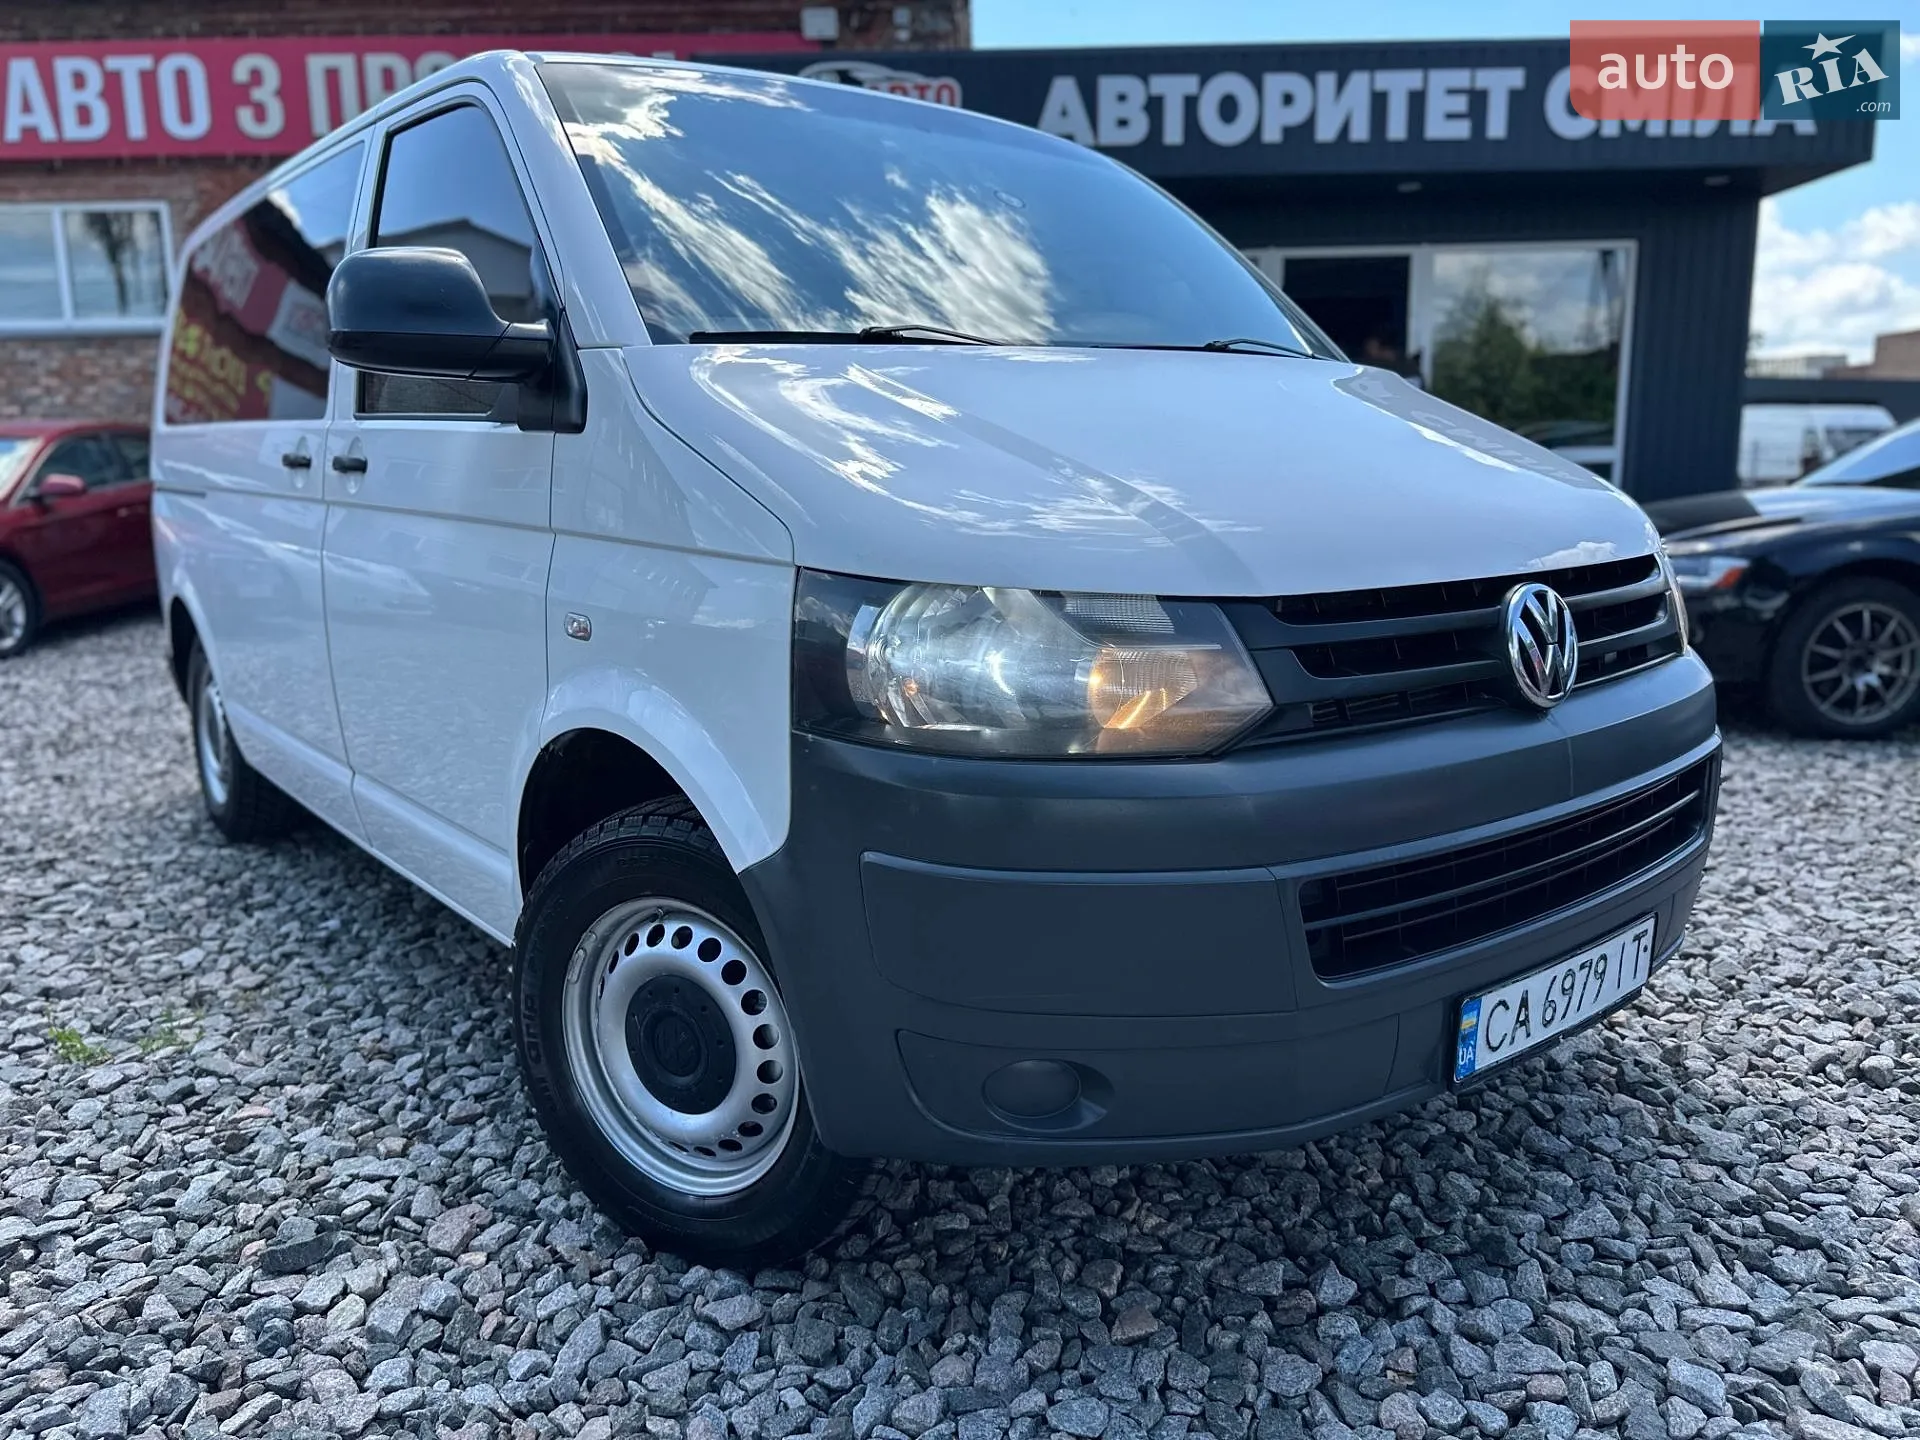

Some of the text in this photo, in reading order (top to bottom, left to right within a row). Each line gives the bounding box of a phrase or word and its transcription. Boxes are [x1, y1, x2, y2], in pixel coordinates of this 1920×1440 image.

[3, 51, 212, 143] АВТО
[1037, 67, 1527, 148] АВТОРИТЕТ
[1485, 989, 1532, 1052] CA
[1541, 952, 1609, 1029] 6979
[1458, 1045, 1475, 1066] UA
